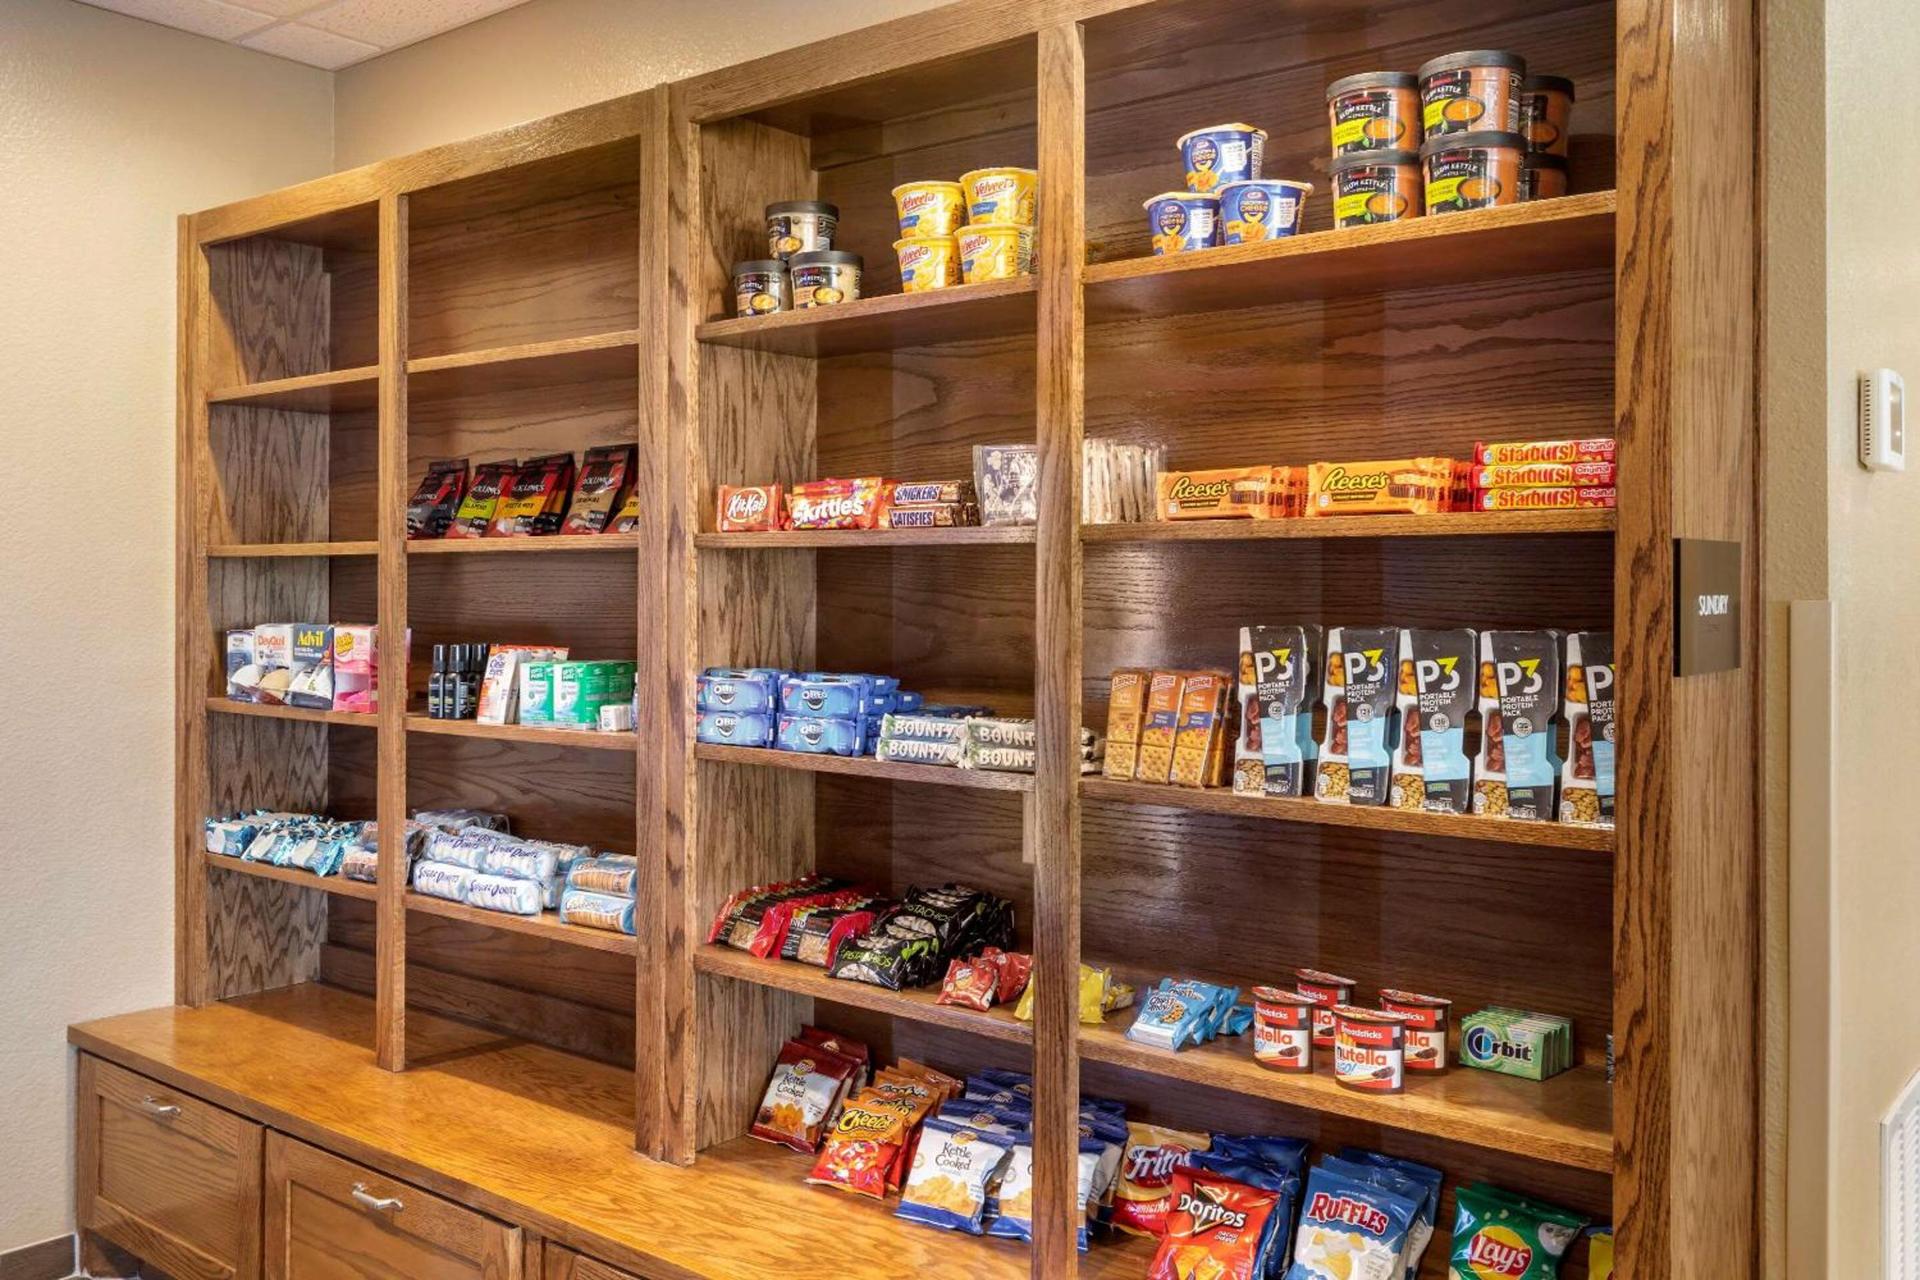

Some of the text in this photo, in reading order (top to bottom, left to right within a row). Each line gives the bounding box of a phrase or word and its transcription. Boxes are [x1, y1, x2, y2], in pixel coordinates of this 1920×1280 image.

[1450, 162, 1478, 173] KETTLE
[975, 178, 1016, 197] Velveeta
[1499, 443, 1575, 463] Starburst
[1321, 466, 1390, 492] Reese's
[1494, 466, 1572, 486] Starburst
[896, 485, 940, 501] SNICKERS
[1169, 476, 1231, 499] Reese's
[1498, 488, 1576, 507] Starburst
[792, 496, 864, 526] Skittles
[1698, 594, 1729, 616] SUNDRY
[258, 635, 285, 649] DayQuil
[297, 631, 324, 647] Advil
[1254, 648, 1293, 683] P3
[1344, 649, 1385, 685] P3
[1415, 656, 1460, 693] P3
[1258, 681, 1290, 690] PORTABLE
[1346, 682, 1381, 692] PORTABLE
[1497, 659, 1543, 697] P3
[1585, 664, 1616, 701] P
[714, 684, 737, 695] OREO
[802, 689, 828, 699] OREO
[1259, 688, 1286, 696] PROTEIN
[1347, 690, 1376, 698] PROTEIN
[1420, 691, 1456, 701] PORTABLE
[1420, 698, 1451, 707] PROTEIN
[1501, 695, 1539, 705] PORTABLE
[1502, 702, 1533, 711] PROTEIN
[1592, 714, 1613, 722] PACK
[894, 720, 952, 738] BOUNTY
[980, 728, 1036, 747] BOUNT
[889, 742, 946, 759] BOUNTY
[979, 750, 1036, 767] BOUNT
[1467, 1025, 1532, 1063] Orbit
[1336, 1046, 1387, 1066] nutella
[784, 1073, 806, 1087] Kettle
[777, 1082, 806, 1098] Cooked
[837, 1108, 896, 1132] Cheetos
[942, 1141, 972, 1158] Kettle
[935, 1153, 971, 1171] Cooked
[1177, 1193, 1247, 1228] Doritos
[1307, 1192, 1389, 1235] RUFFLES
[1471, 1234, 1529, 1273] Lay's
